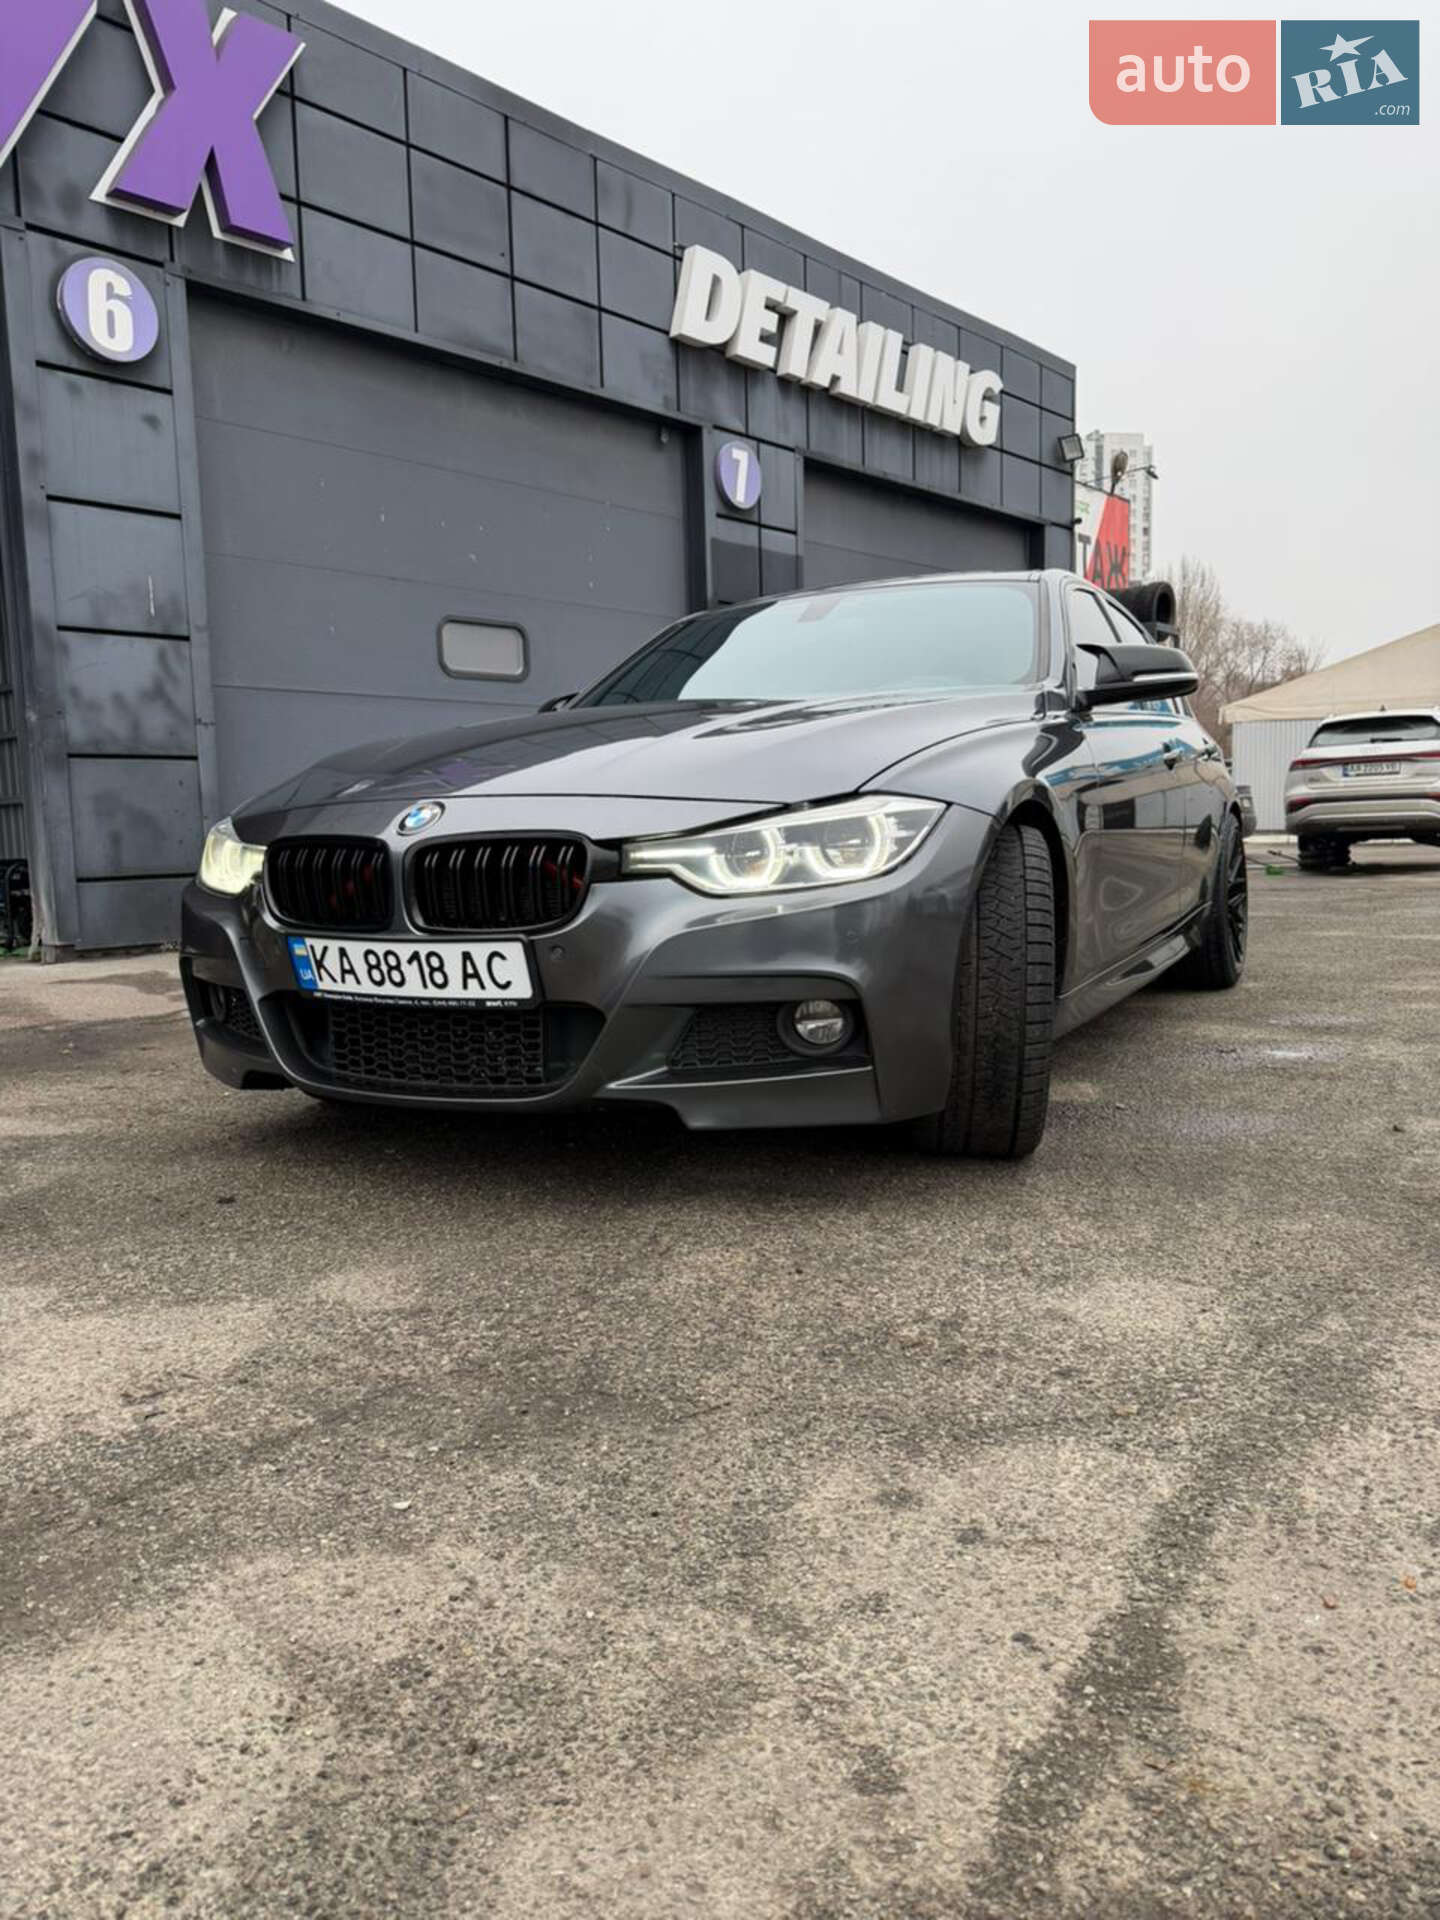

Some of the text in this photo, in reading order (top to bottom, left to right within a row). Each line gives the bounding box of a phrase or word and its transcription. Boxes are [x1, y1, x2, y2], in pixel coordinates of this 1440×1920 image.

[87, 267, 134, 352] 6
[669, 244, 1004, 447] DETAILING
[731, 448, 750, 506] 7
[309, 944, 513, 991] KA 8818 AC
